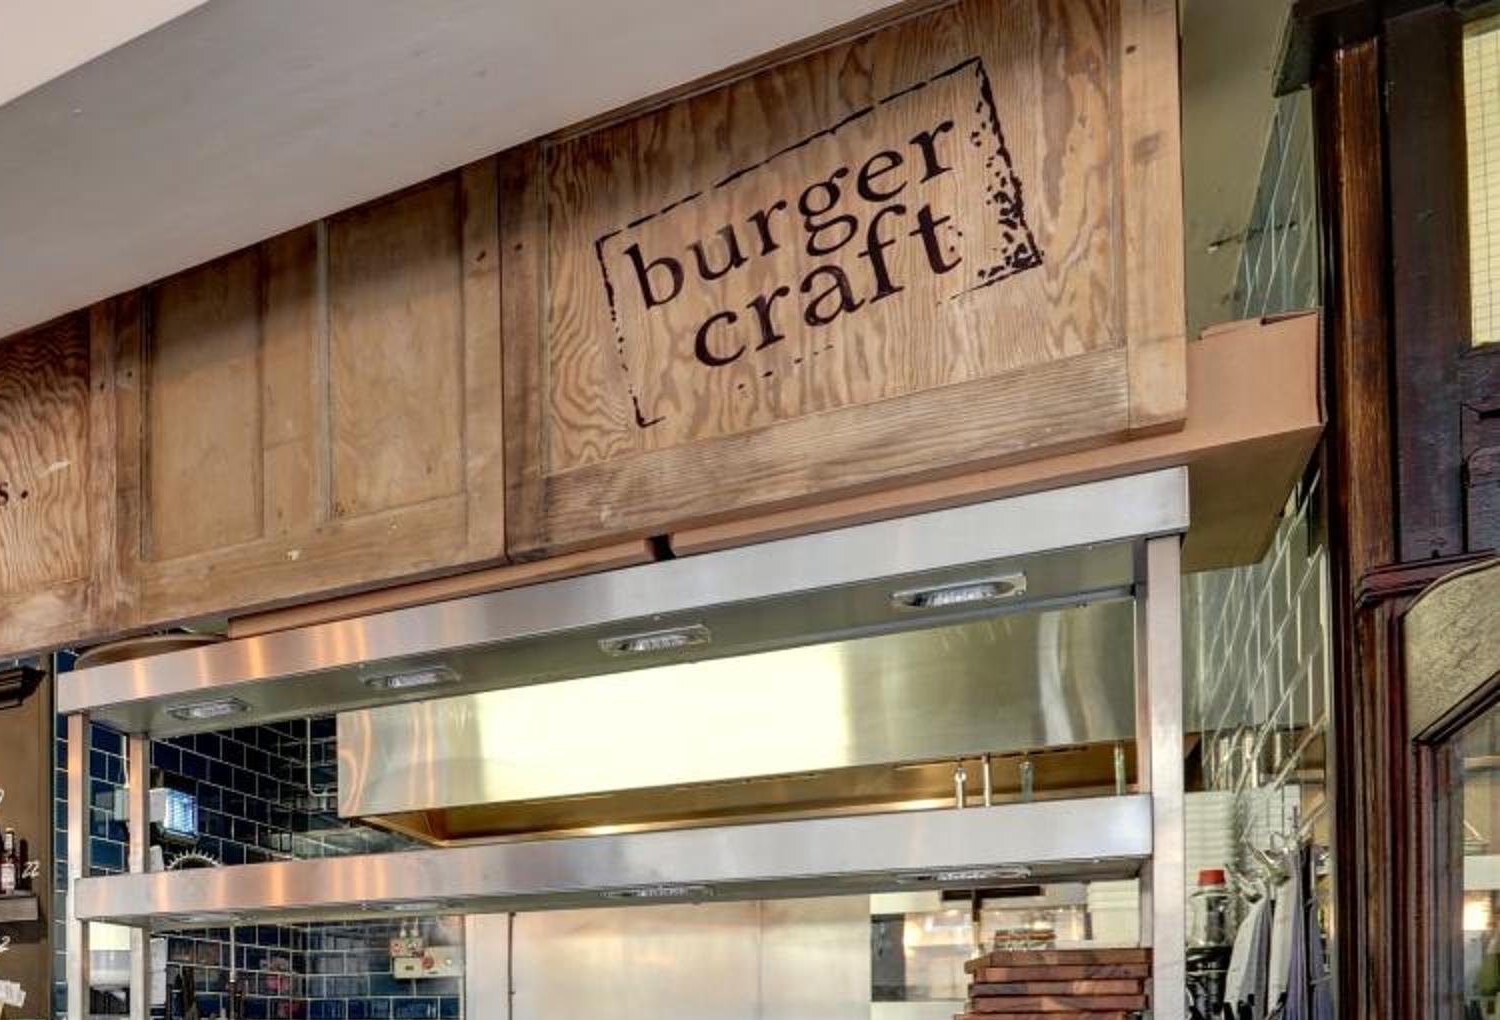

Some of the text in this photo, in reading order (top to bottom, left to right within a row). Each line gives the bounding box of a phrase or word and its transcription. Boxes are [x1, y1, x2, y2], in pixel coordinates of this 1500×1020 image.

[623, 119, 954, 310] burger
[693, 202, 964, 367] craft
[21, 860, 40, 879] 22
